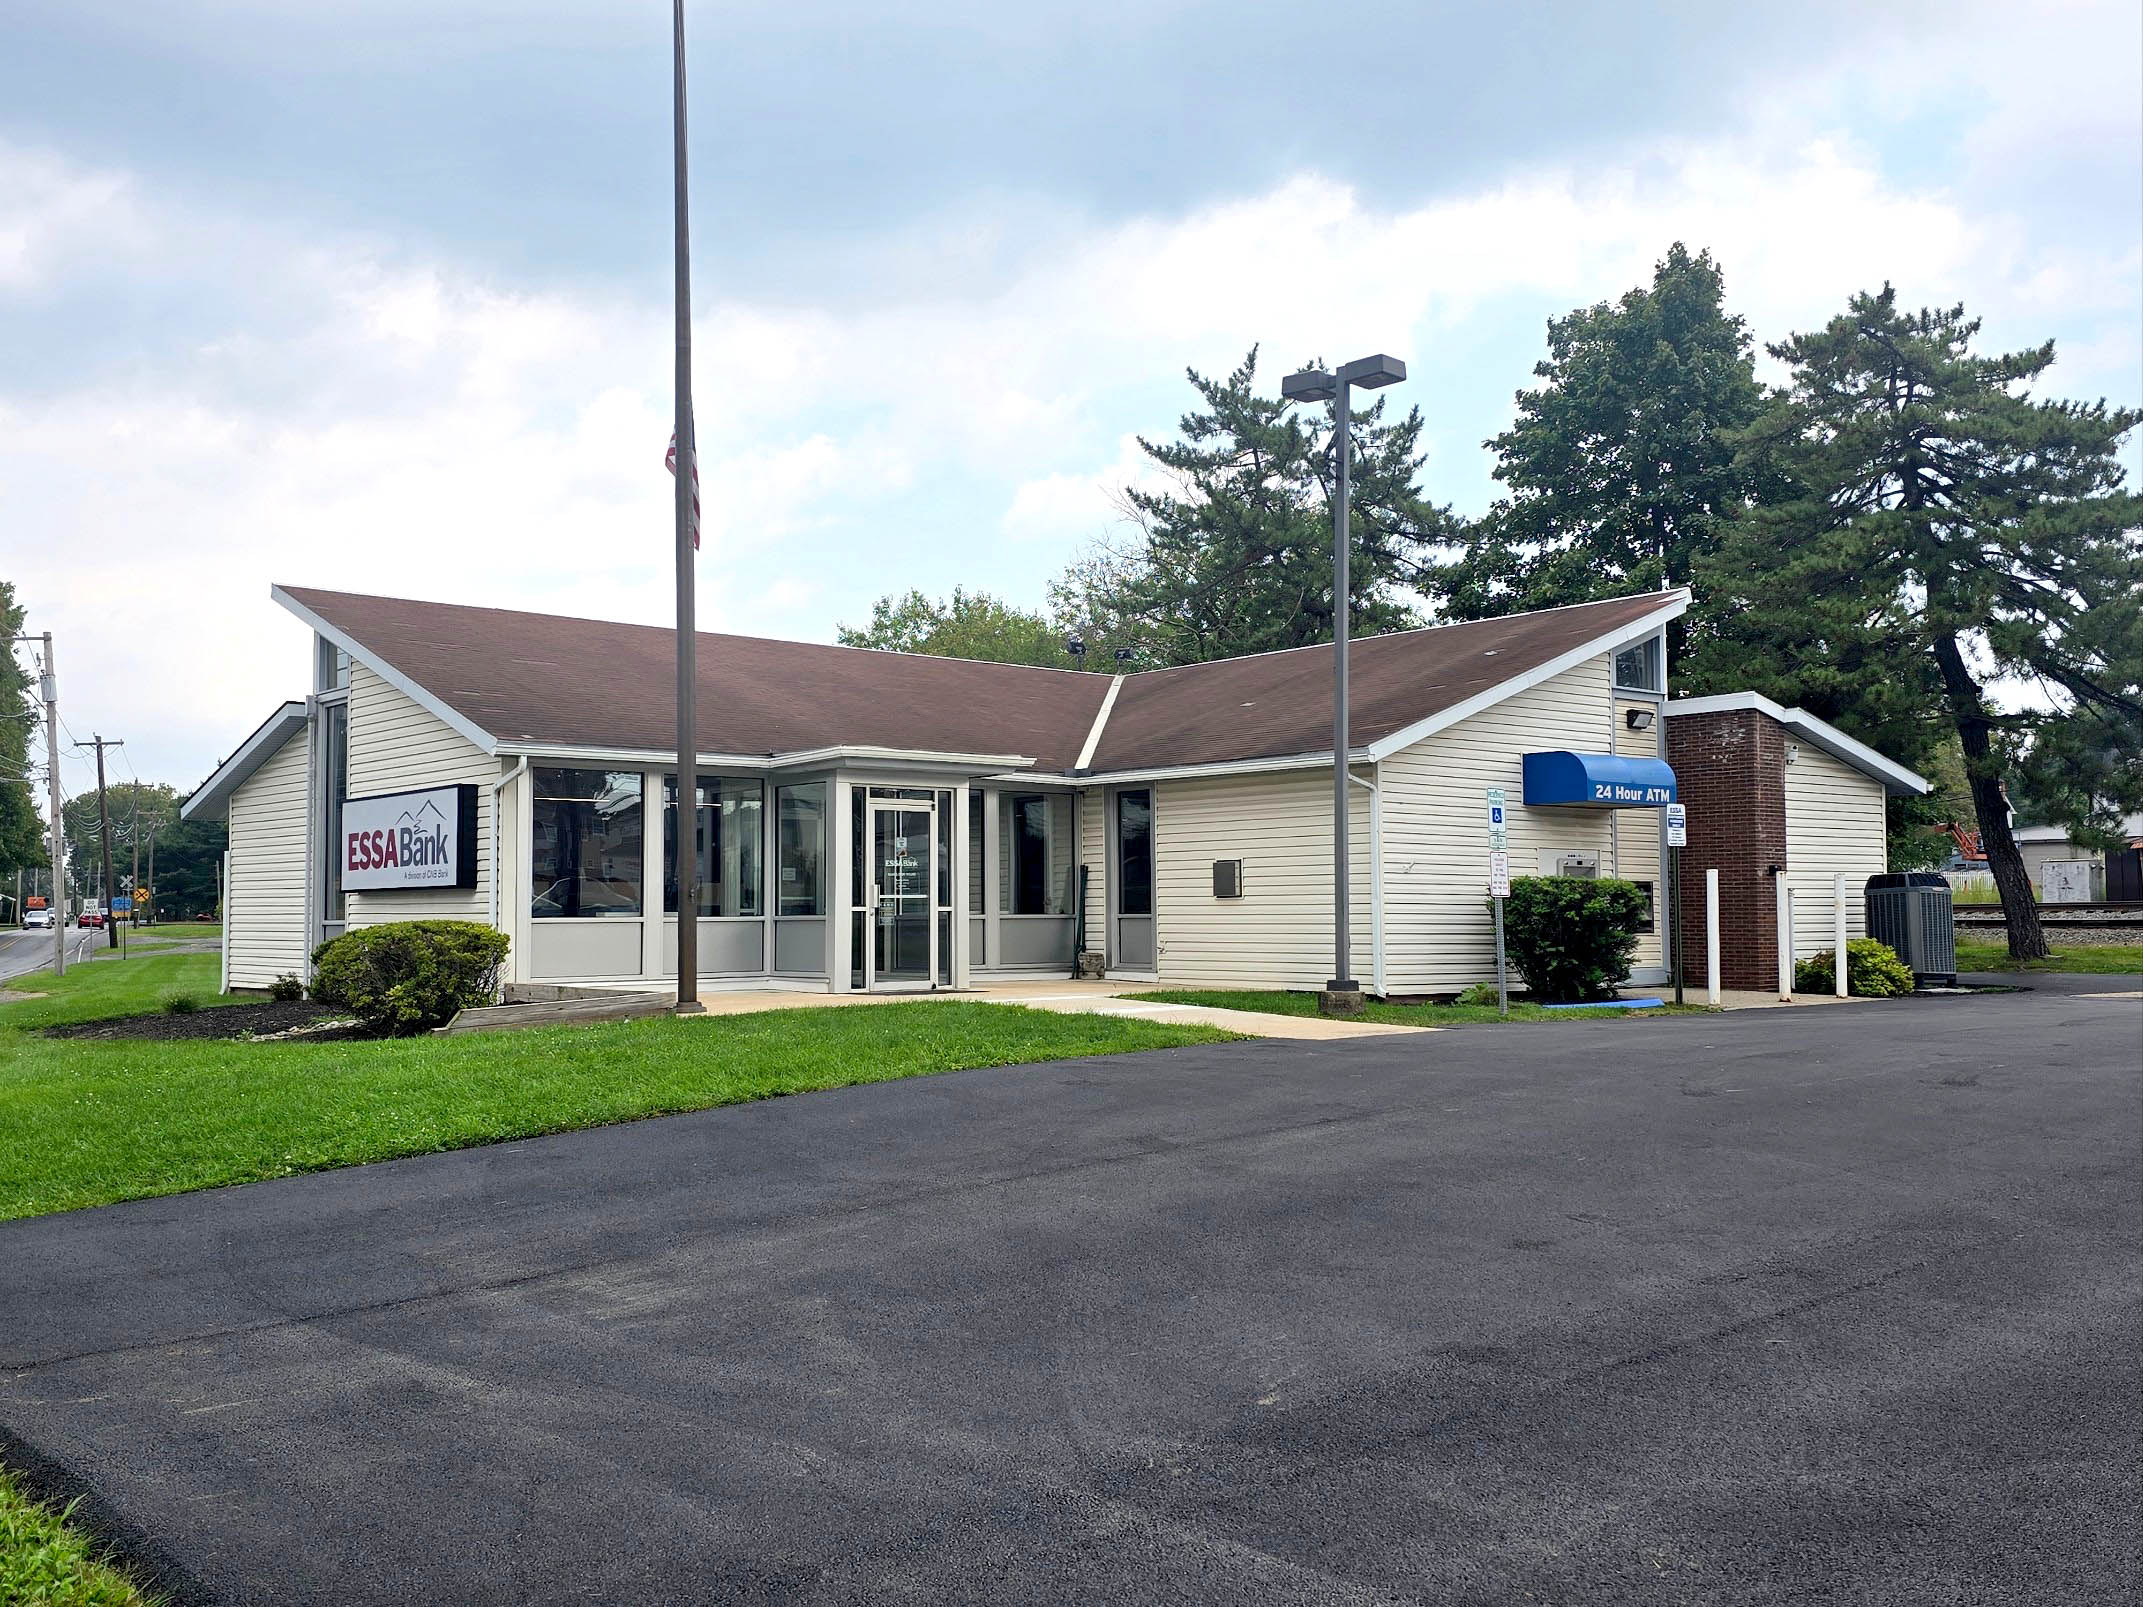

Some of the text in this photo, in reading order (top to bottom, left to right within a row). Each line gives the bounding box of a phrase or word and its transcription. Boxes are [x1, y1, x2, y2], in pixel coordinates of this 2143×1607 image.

[1595, 784, 1670, 802] 24 Hour ATM
